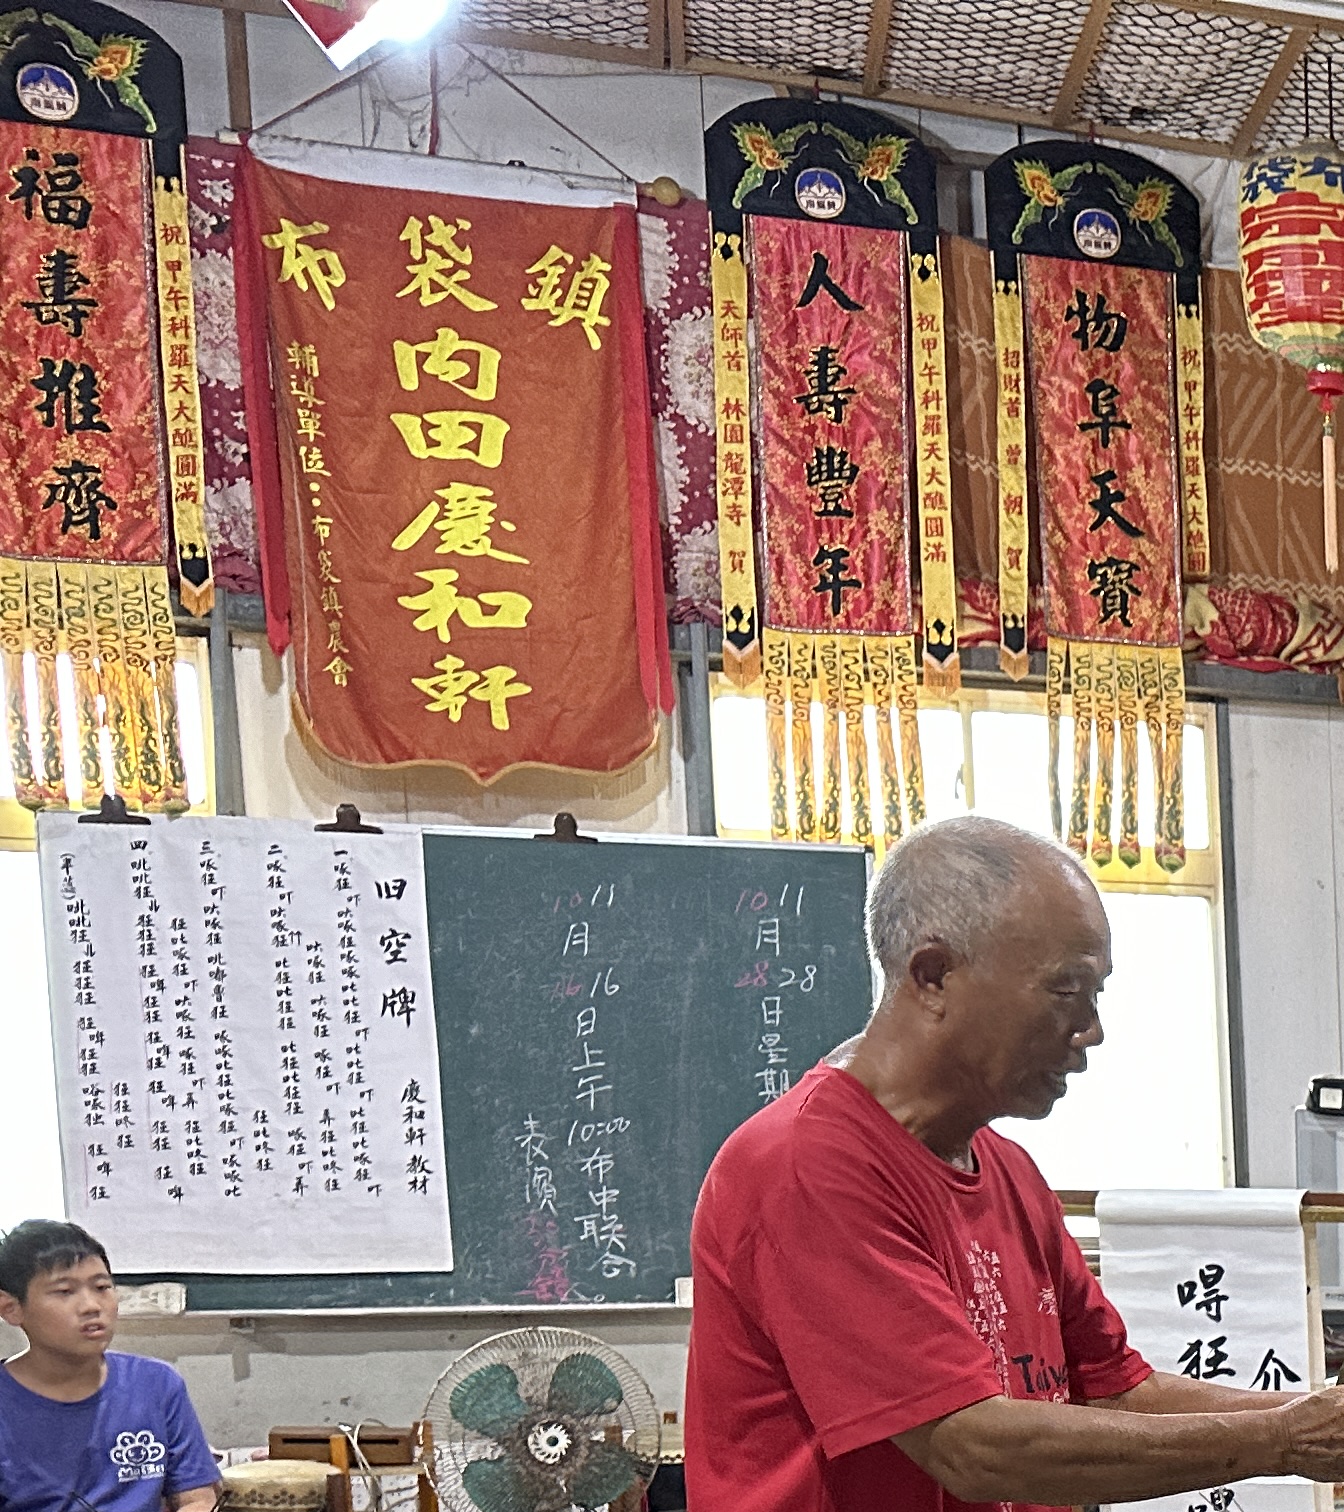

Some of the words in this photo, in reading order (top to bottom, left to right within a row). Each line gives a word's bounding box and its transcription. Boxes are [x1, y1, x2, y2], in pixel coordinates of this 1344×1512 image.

[792, 252, 864, 618] 人壽豐年
[1064, 288, 1147, 627] 物阜天寶
